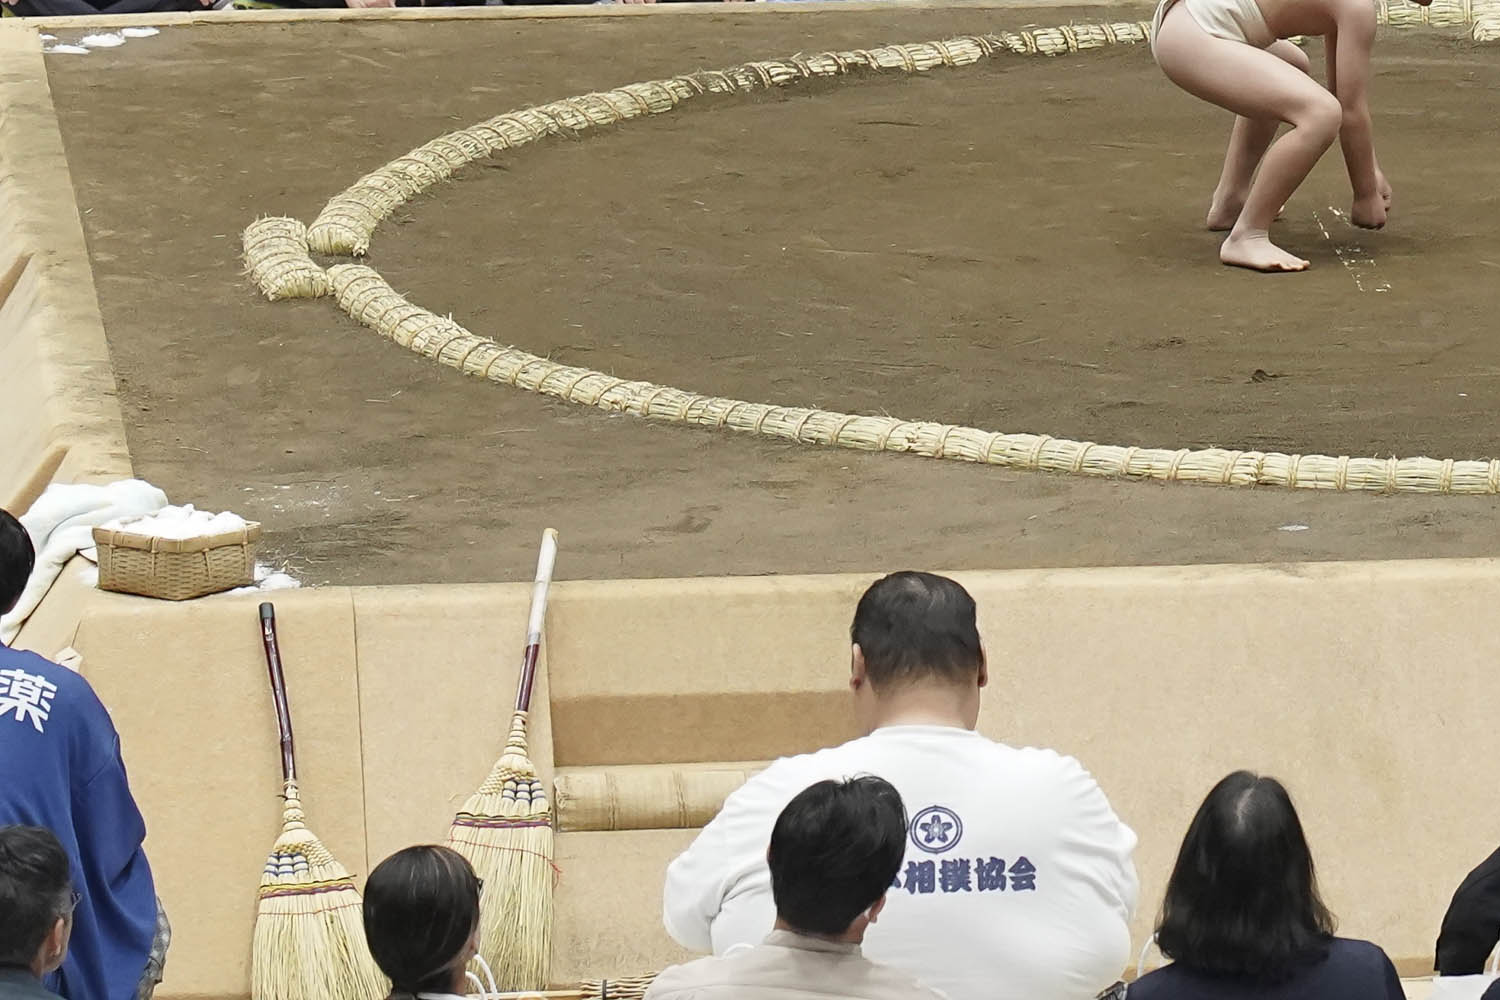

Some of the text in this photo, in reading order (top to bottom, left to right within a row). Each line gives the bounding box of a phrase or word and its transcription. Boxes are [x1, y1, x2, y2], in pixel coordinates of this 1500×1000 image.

[0, 668, 58, 734] 薬
[891, 856, 1036, 894] 相撲協会
